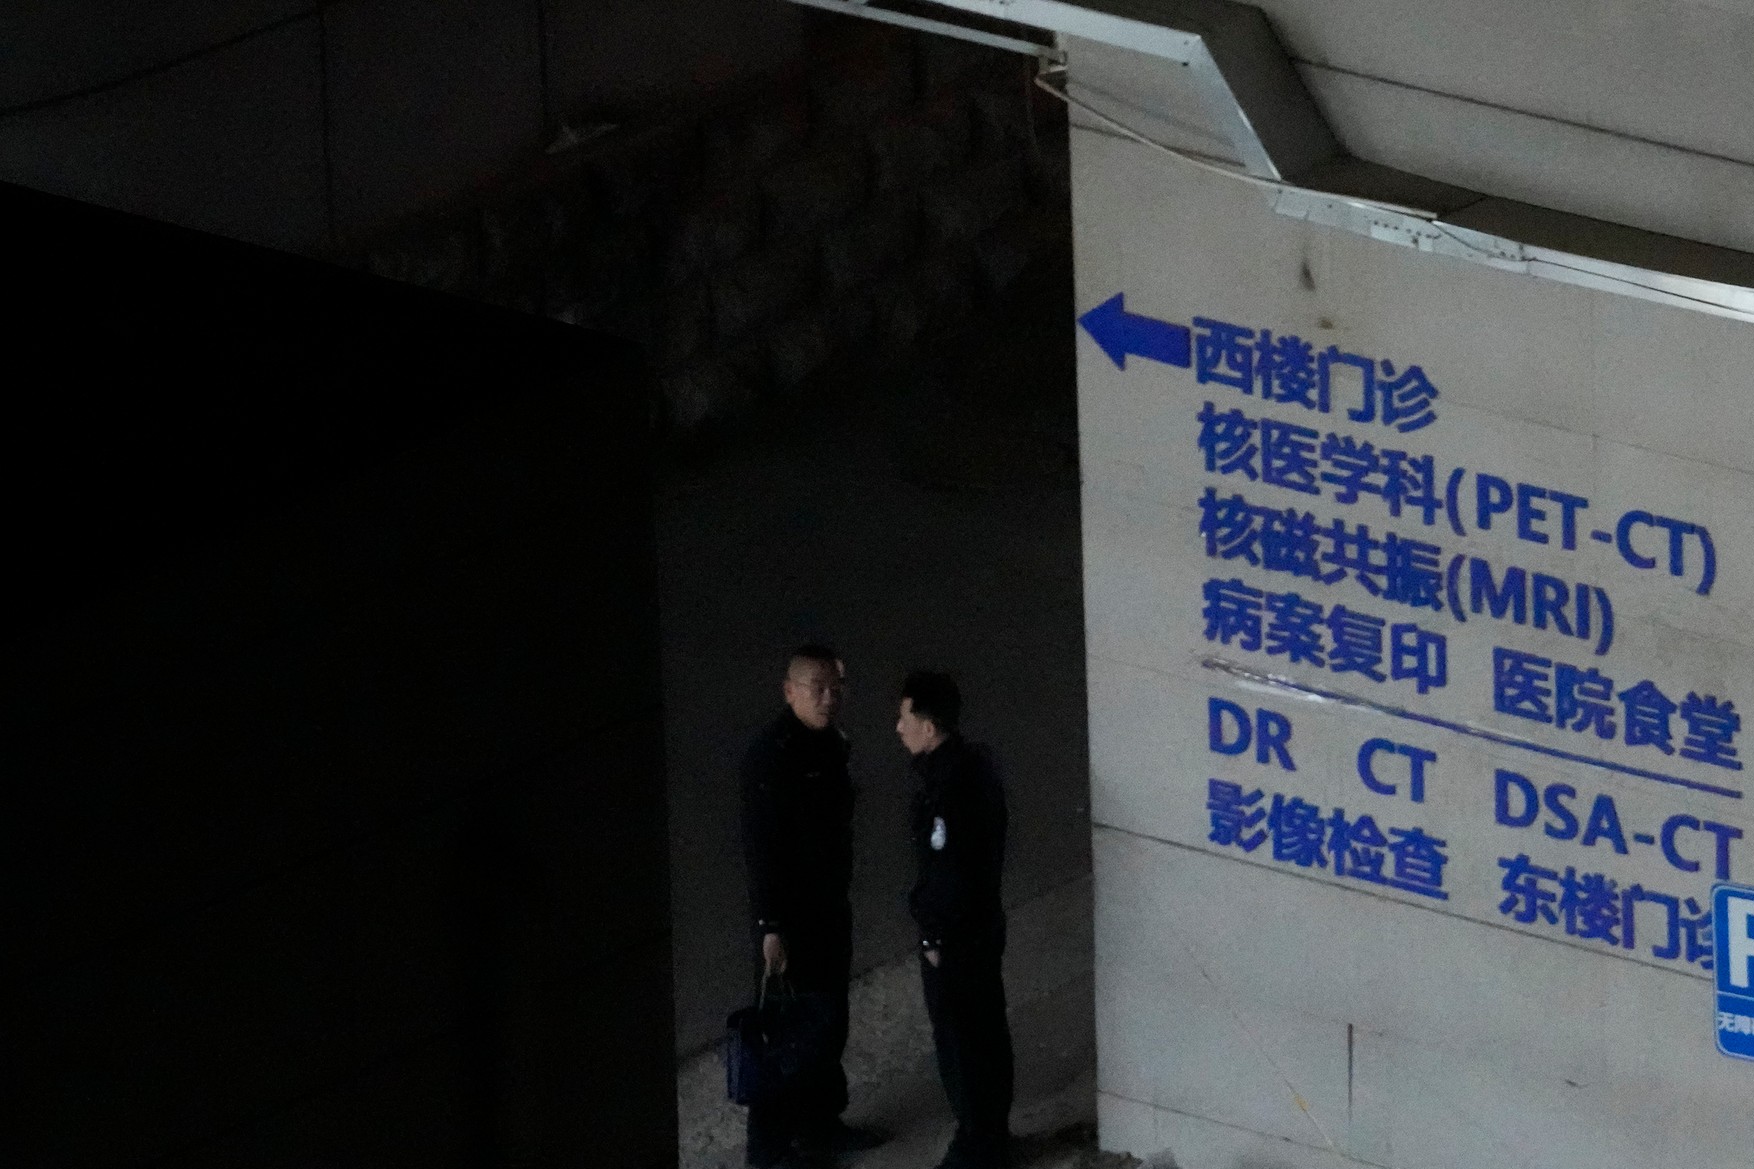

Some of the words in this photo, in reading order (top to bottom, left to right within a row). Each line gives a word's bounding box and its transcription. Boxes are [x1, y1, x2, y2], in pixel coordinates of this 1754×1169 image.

[1193, 317, 1438, 433] 西楼门诊
[1202, 579, 1448, 695] 病案复印
[1492, 647, 1742, 770] 医院食堂
[1206, 777, 1449, 901] 影像检查
[1208, 697, 1296, 772] DR
[1356, 738, 1437, 804] CT
[1494, 768, 1743, 882] DSA-CT
